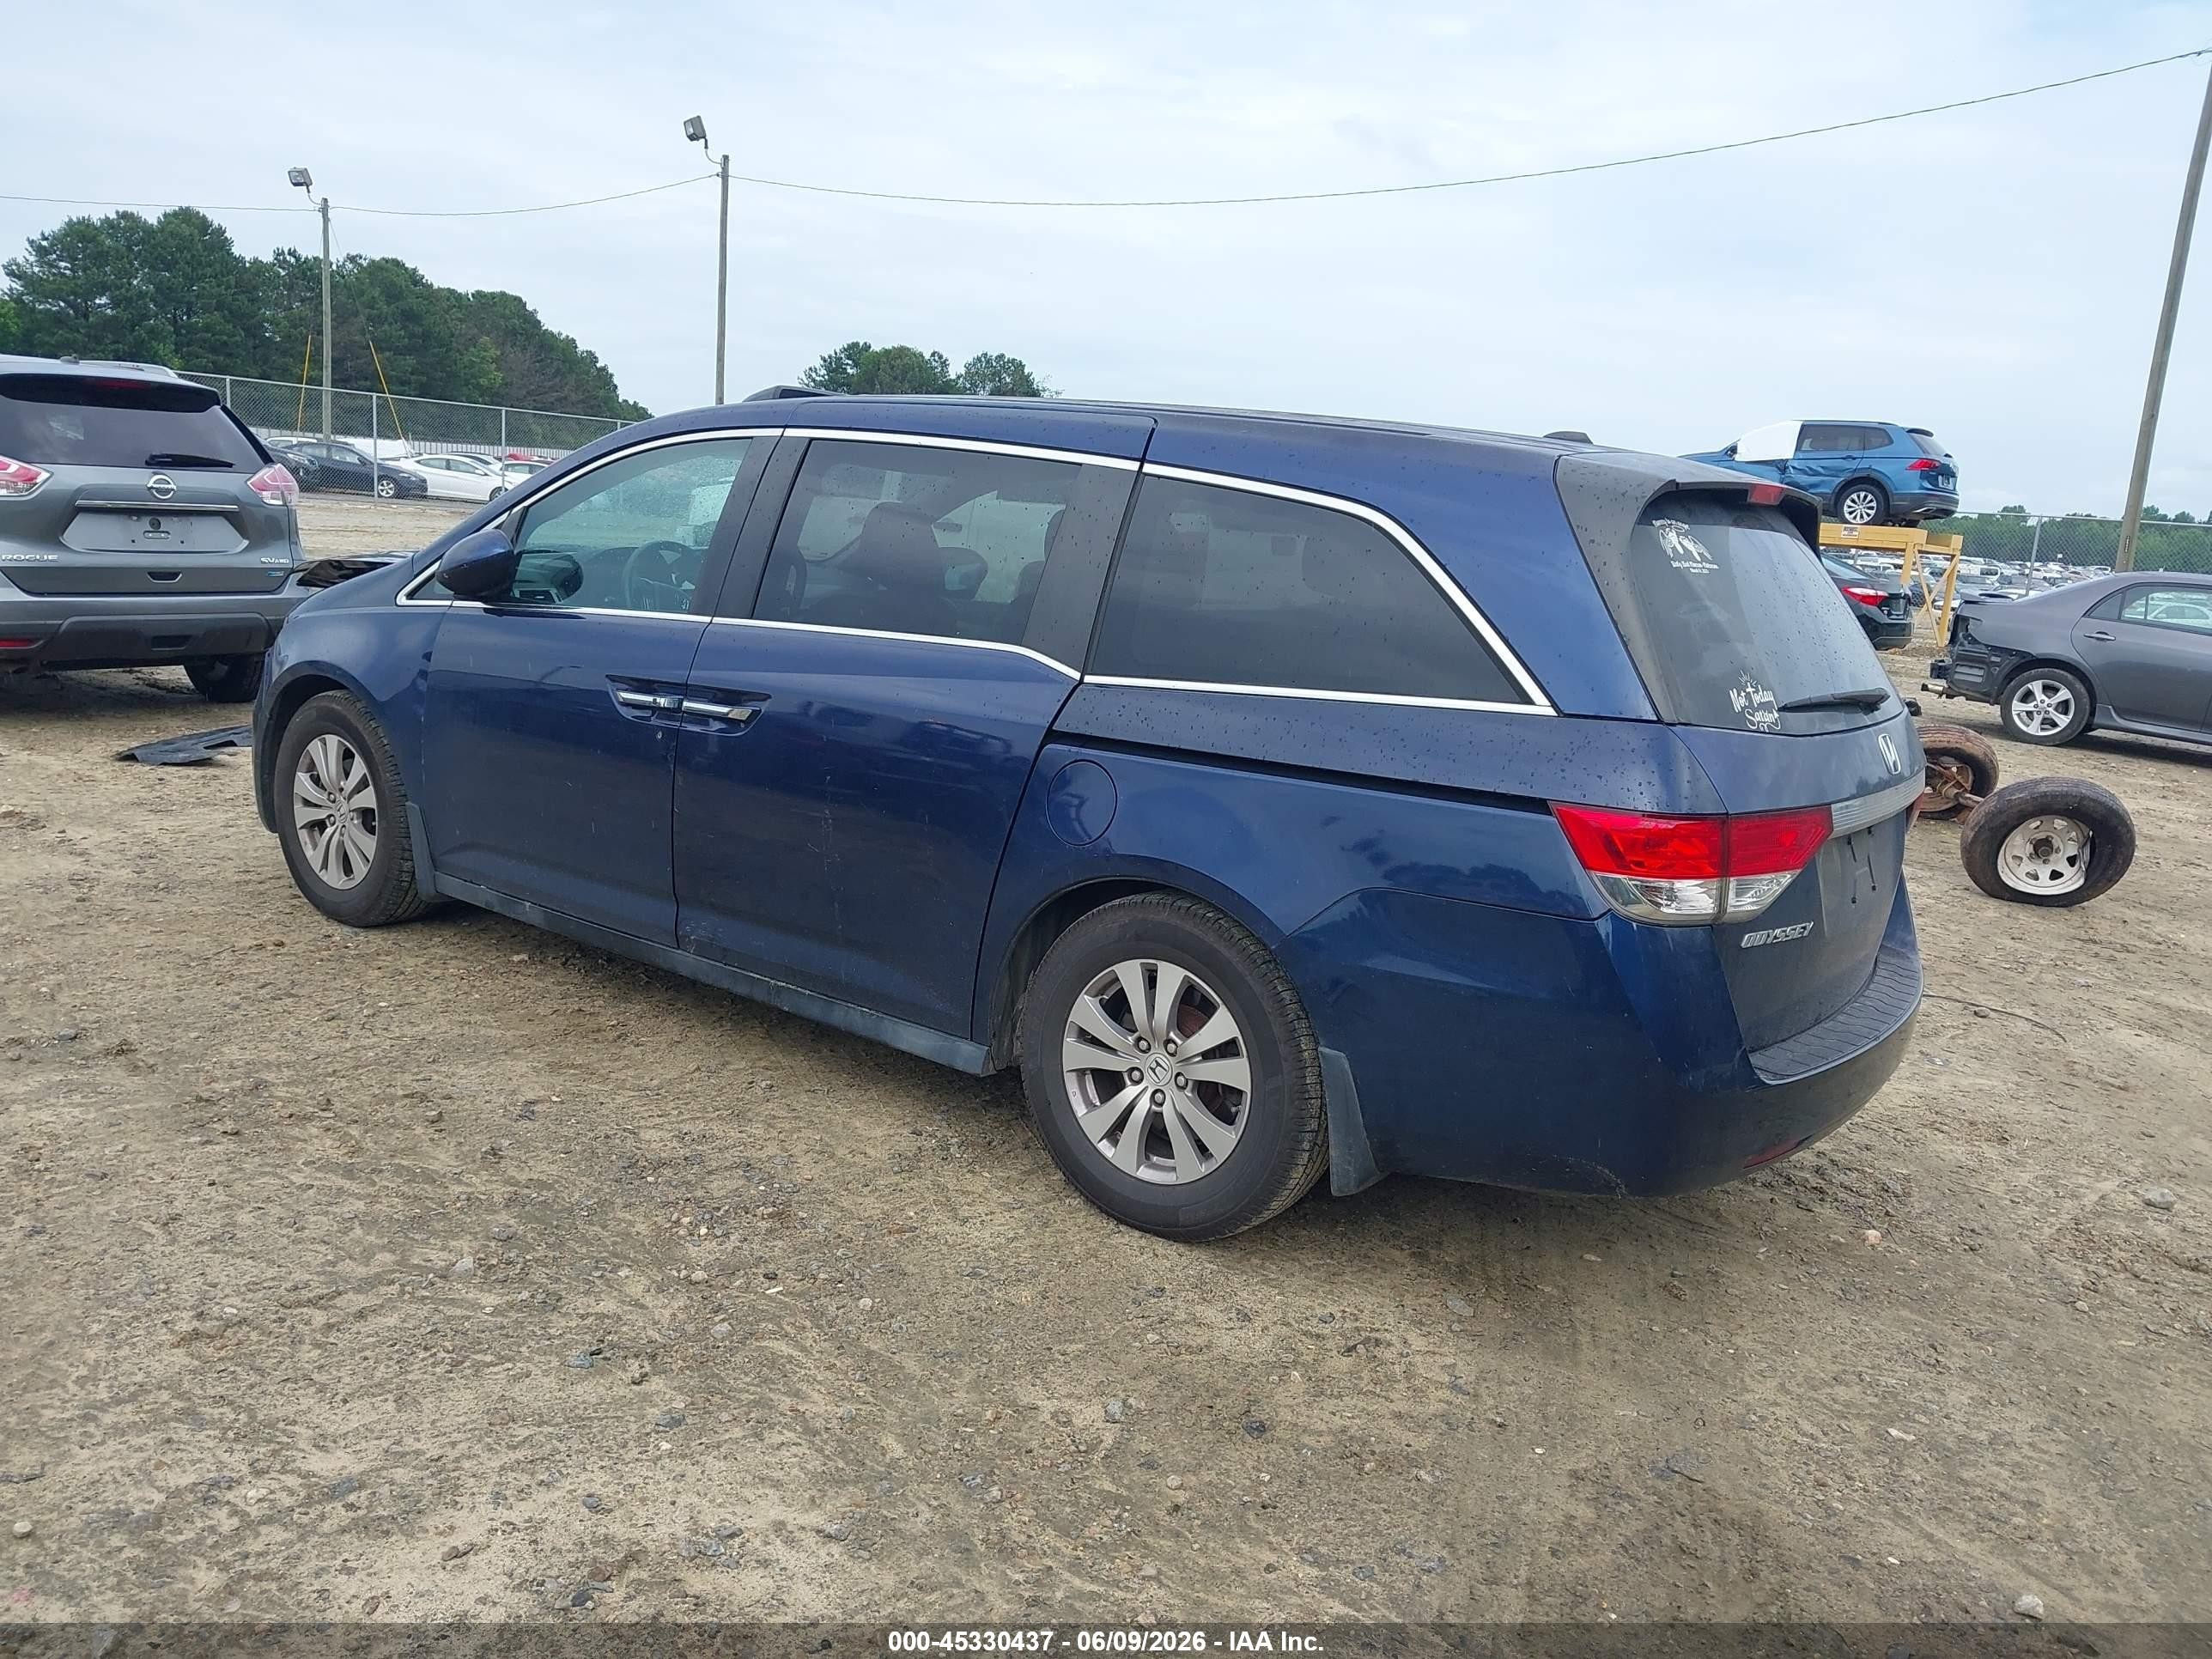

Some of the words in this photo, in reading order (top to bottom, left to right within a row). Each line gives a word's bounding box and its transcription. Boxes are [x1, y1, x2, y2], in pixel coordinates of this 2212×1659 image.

[1729, 688, 1749, 713] Not
[1746, 682, 1778, 710] Today
[1744, 708, 1780, 730] Satan
[1741, 921, 1814, 949] ODYSSEY
